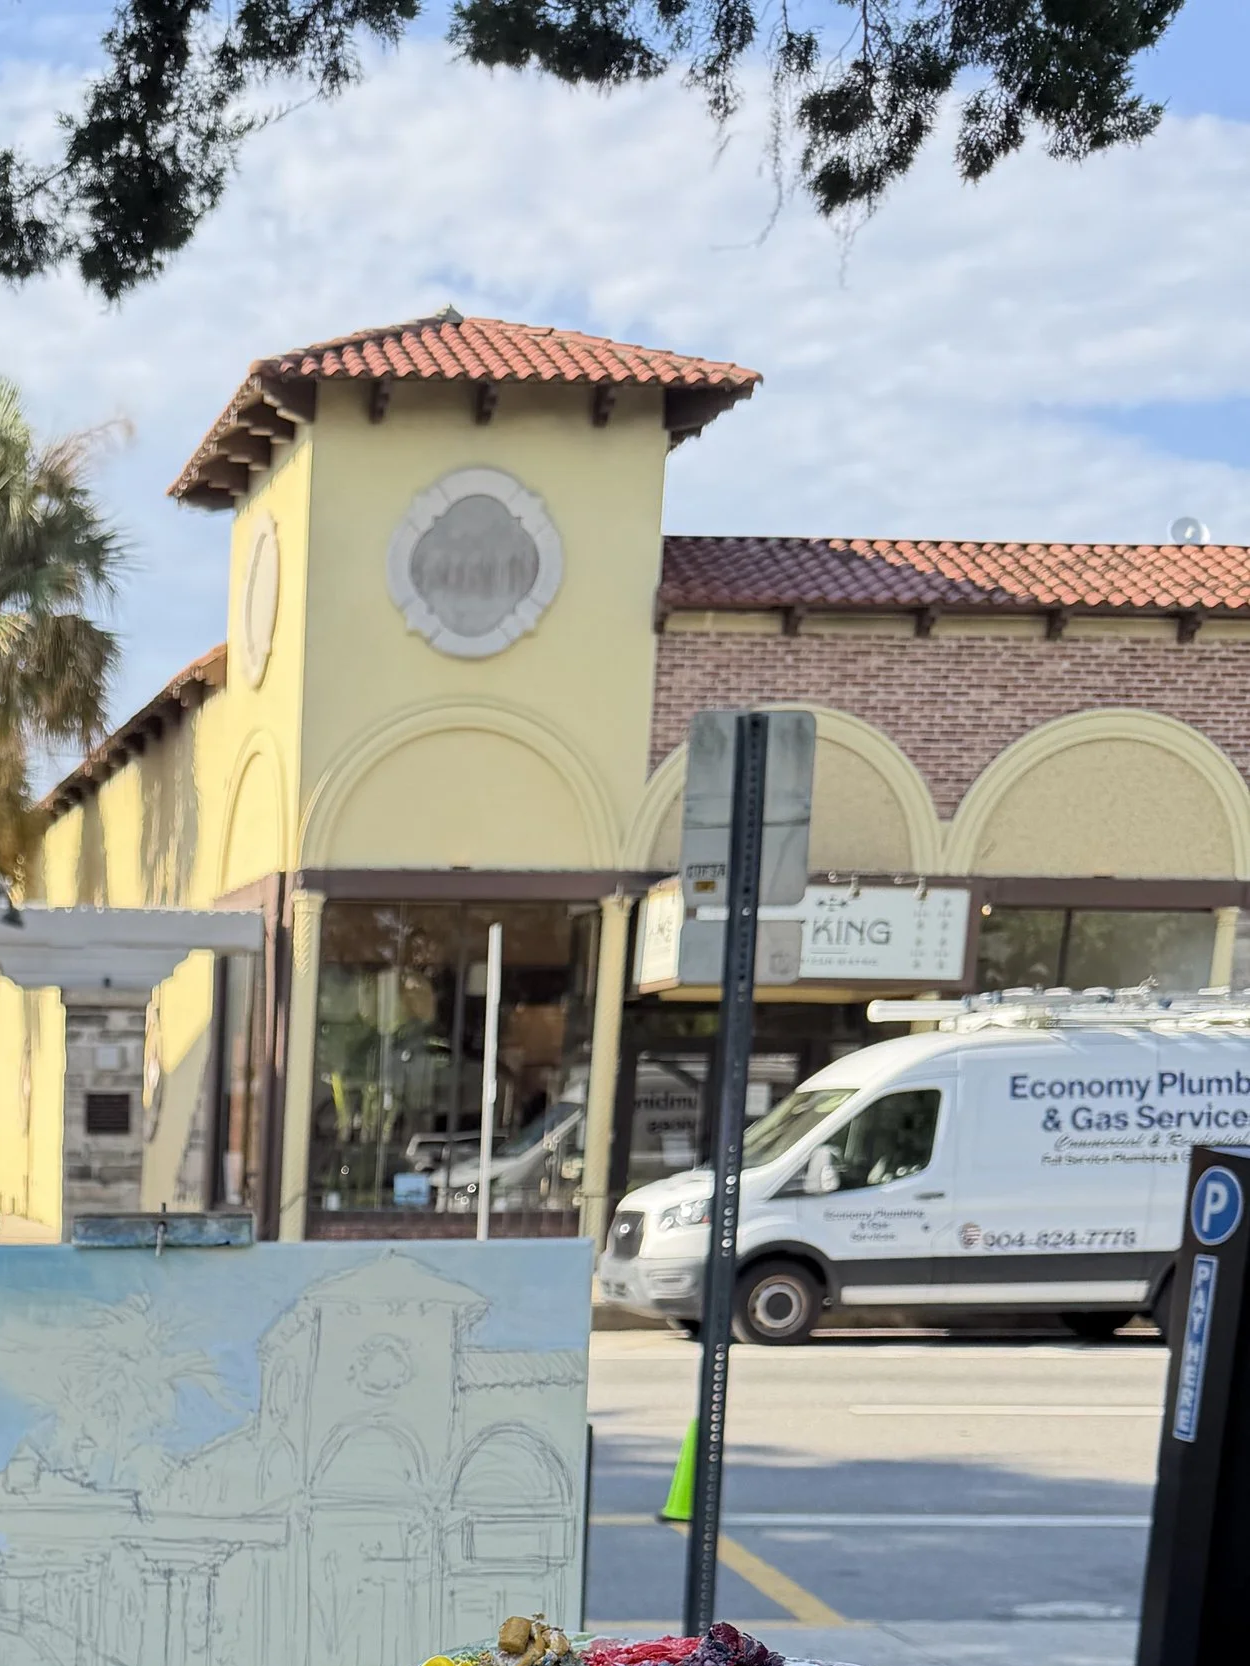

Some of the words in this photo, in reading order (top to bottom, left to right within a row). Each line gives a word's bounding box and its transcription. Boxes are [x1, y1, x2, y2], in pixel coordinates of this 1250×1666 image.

[811, 916, 893, 946] KING
[1010, 1074, 1151, 1101] Economy
[1157, 1070, 1250, 1096] Plumb
[1041, 1107, 1063, 1132] &
[1071, 1106, 1129, 1131] Gas
[1201, 1180, 1229, 1233] P
[1192, 1261, 1211, 1335] PAY
[1177, 1340, 1202, 1432] HERE
